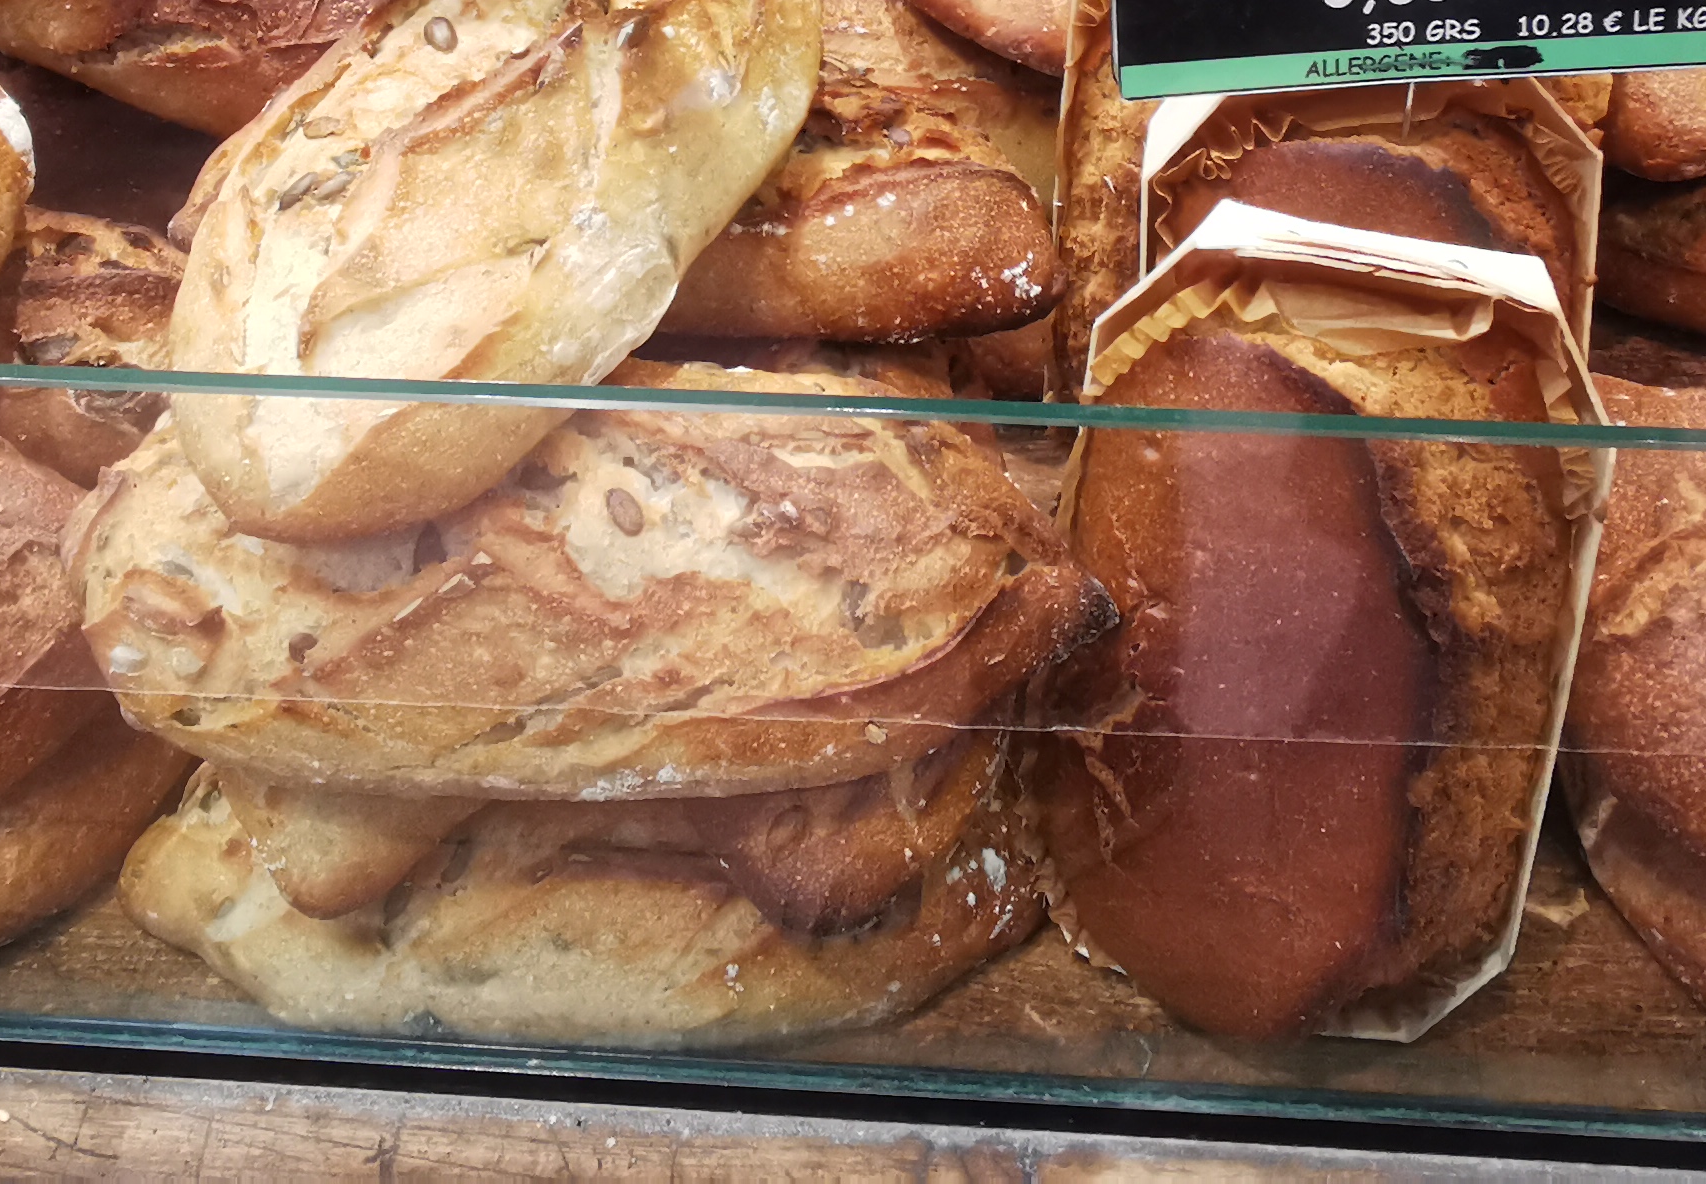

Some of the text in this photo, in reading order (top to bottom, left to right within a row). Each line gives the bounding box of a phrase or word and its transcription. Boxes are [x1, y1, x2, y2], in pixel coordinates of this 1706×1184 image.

[1366, 20, 1481, 46] 350 GRS
[1517, 13, 1593, 37] 10.28
[1603, 12, 1621, 33] €
[1633, 9, 1664, 32] LE
